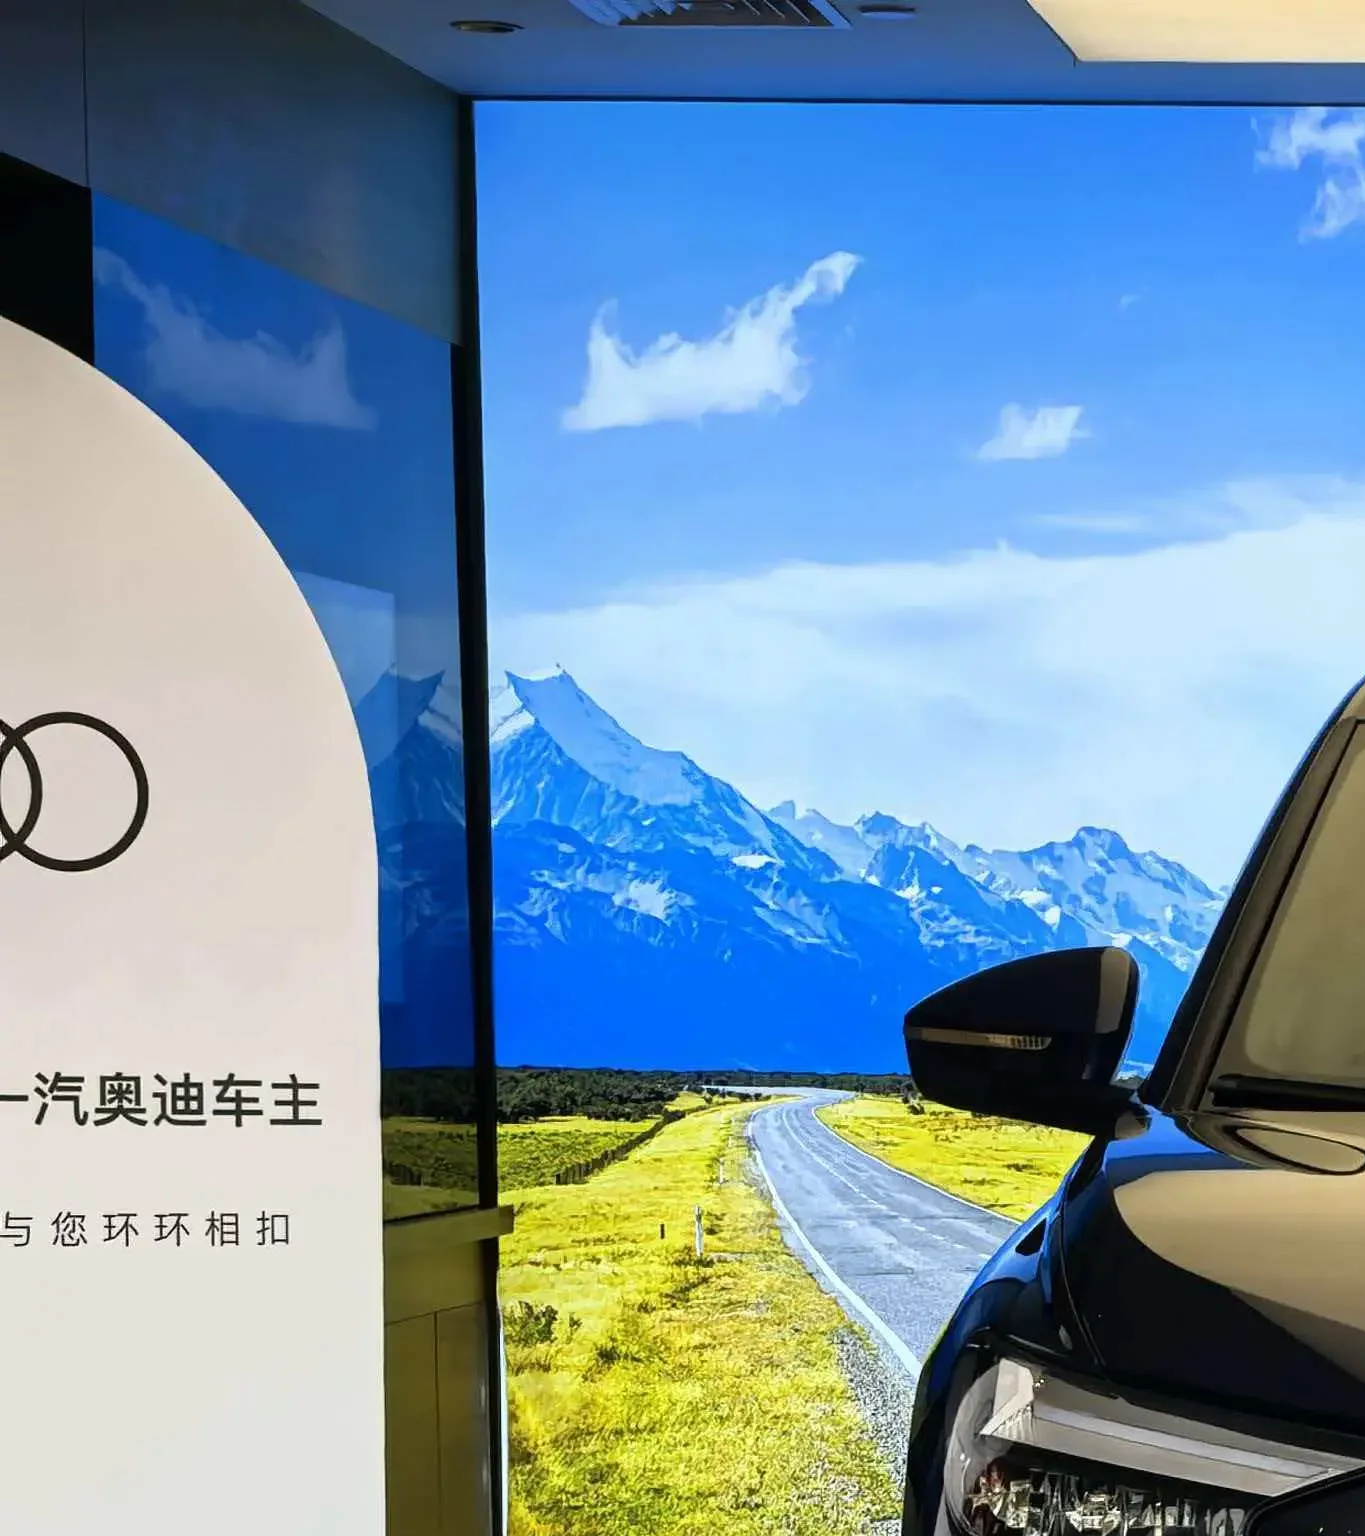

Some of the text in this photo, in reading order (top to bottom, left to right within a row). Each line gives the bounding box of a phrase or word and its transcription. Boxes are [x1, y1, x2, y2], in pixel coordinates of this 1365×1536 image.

[0, 1211, 290, 1247] 与您环环相扣
